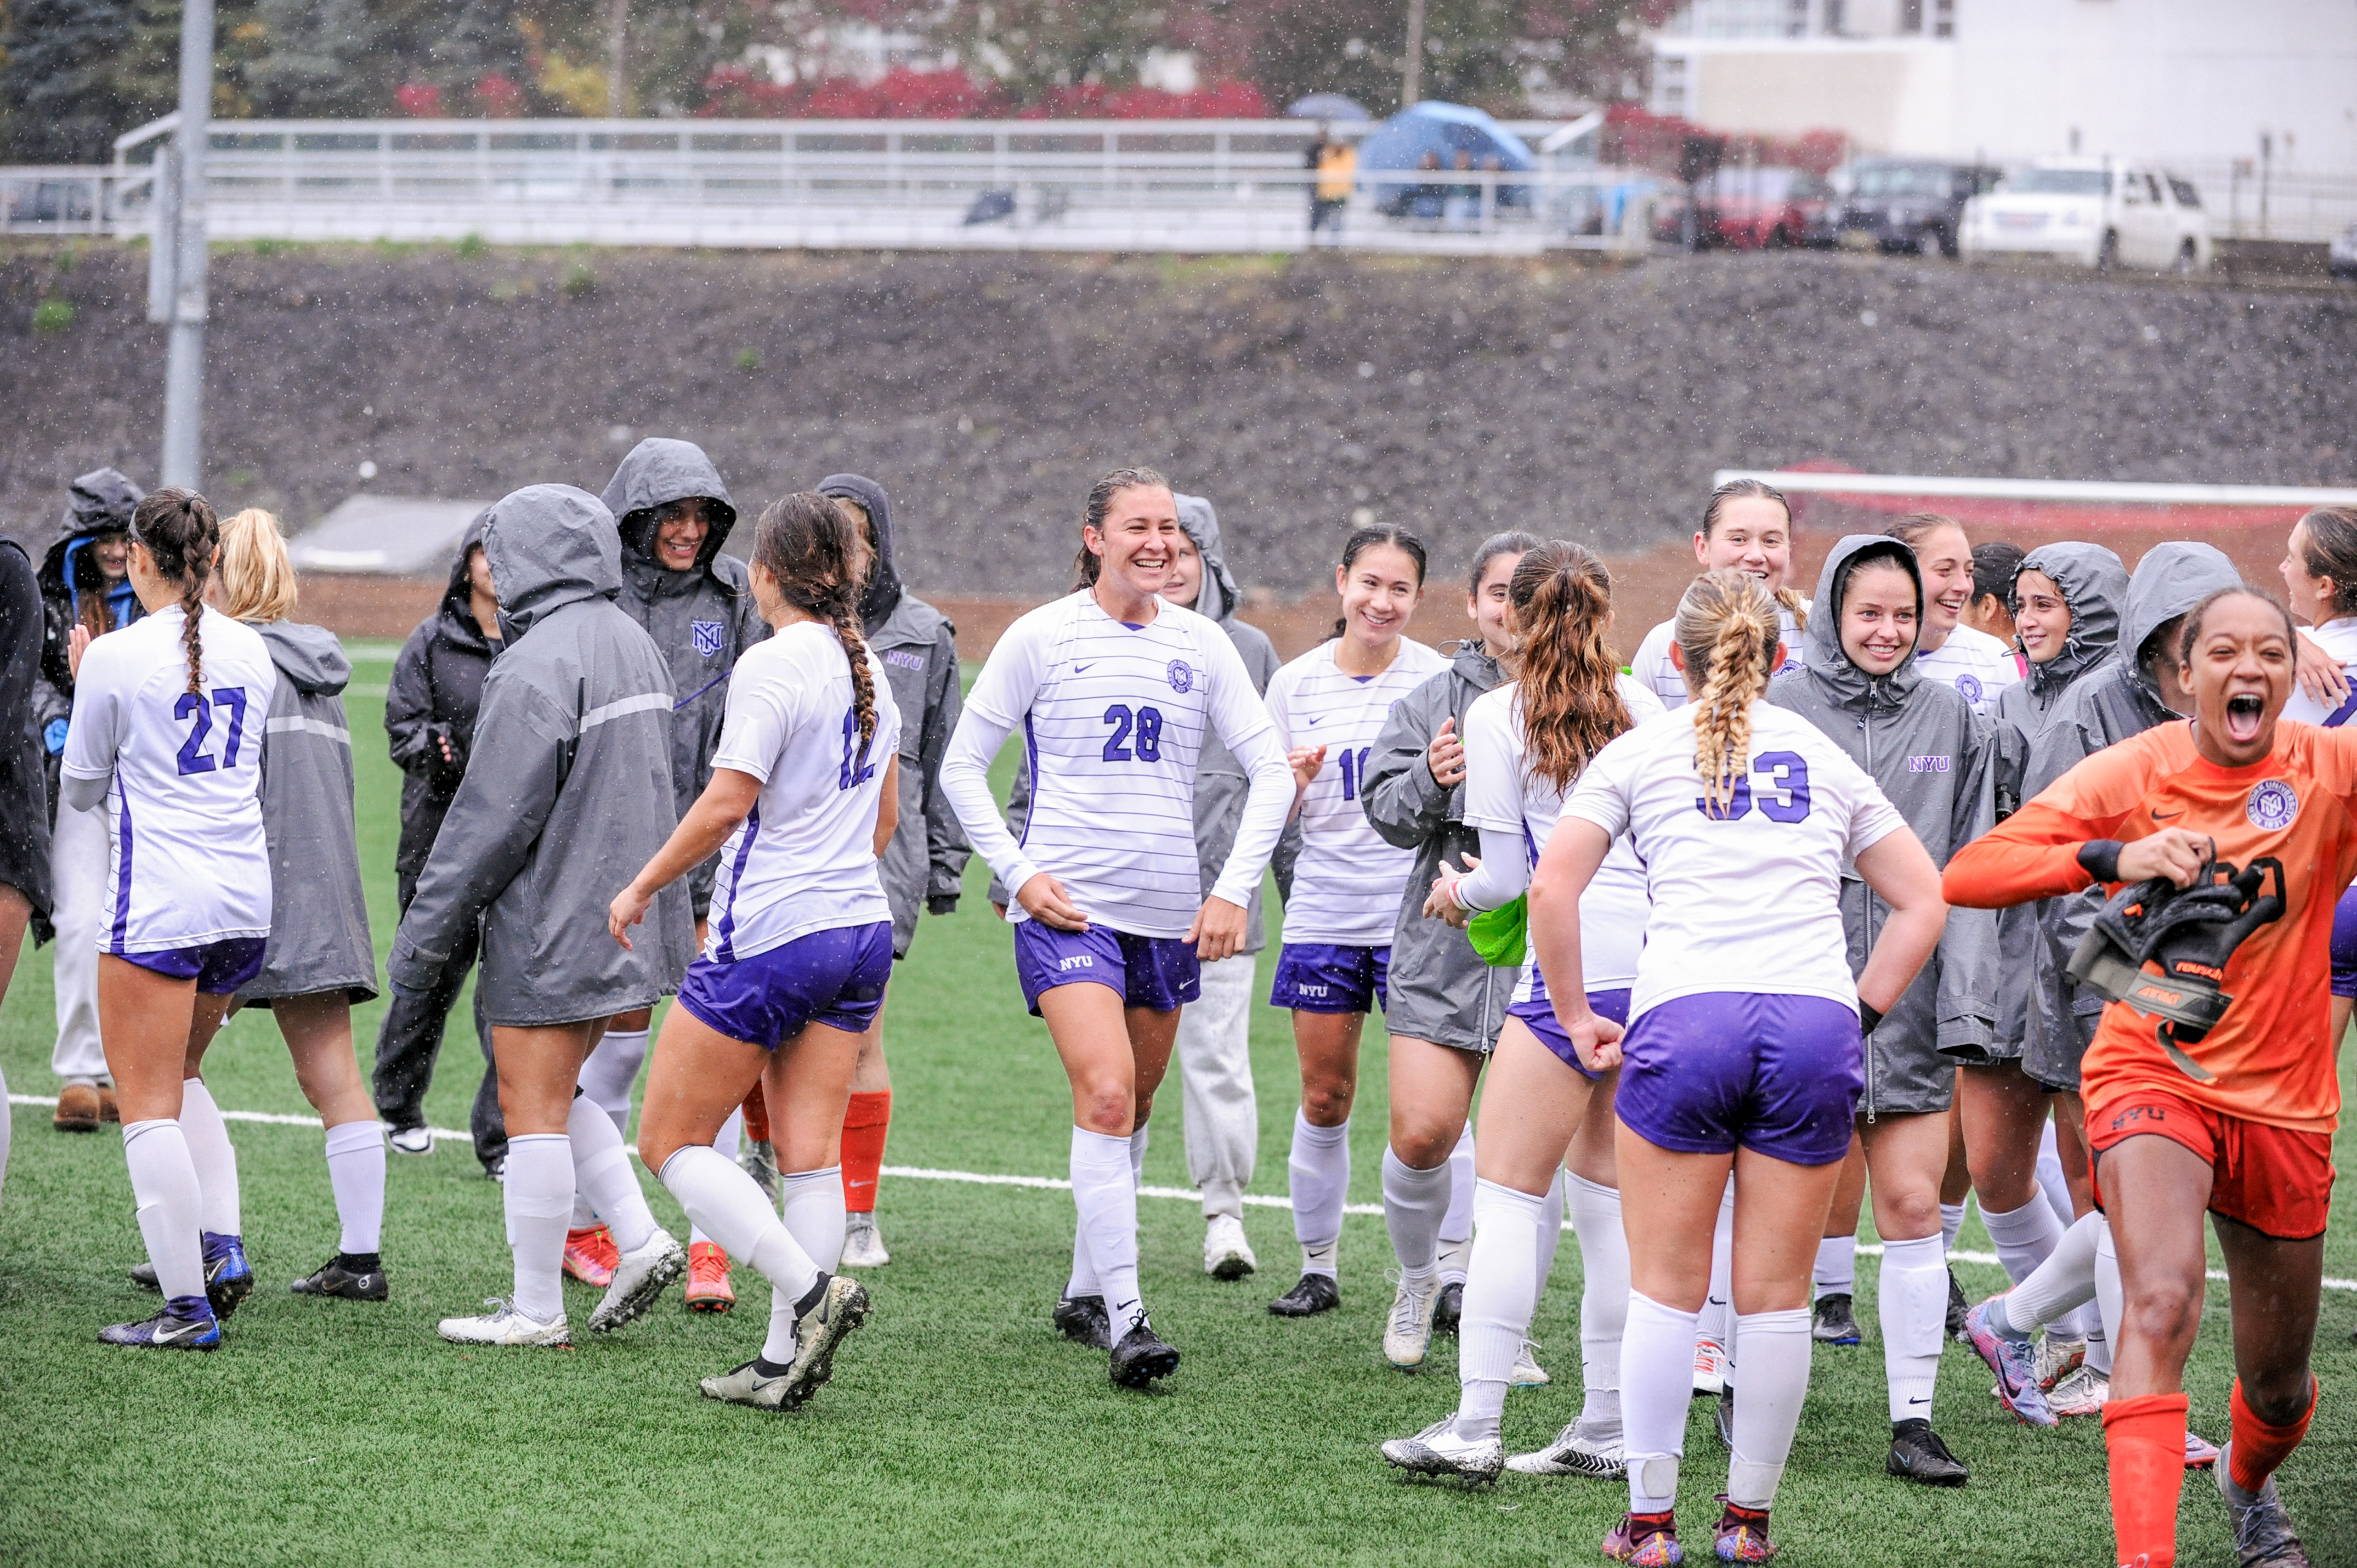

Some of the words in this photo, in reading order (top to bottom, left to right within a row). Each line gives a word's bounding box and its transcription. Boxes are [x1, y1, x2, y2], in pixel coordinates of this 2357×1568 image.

[886, 649, 924, 671] NYU
[174, 687, 247, 776] 27
[1103, 704, 1163, 763] 28
[1908, 755, 1950, 773] NYU
[1059, 955, 1093, 971] NYU
[1299, 983, 1328, 997] NYU
